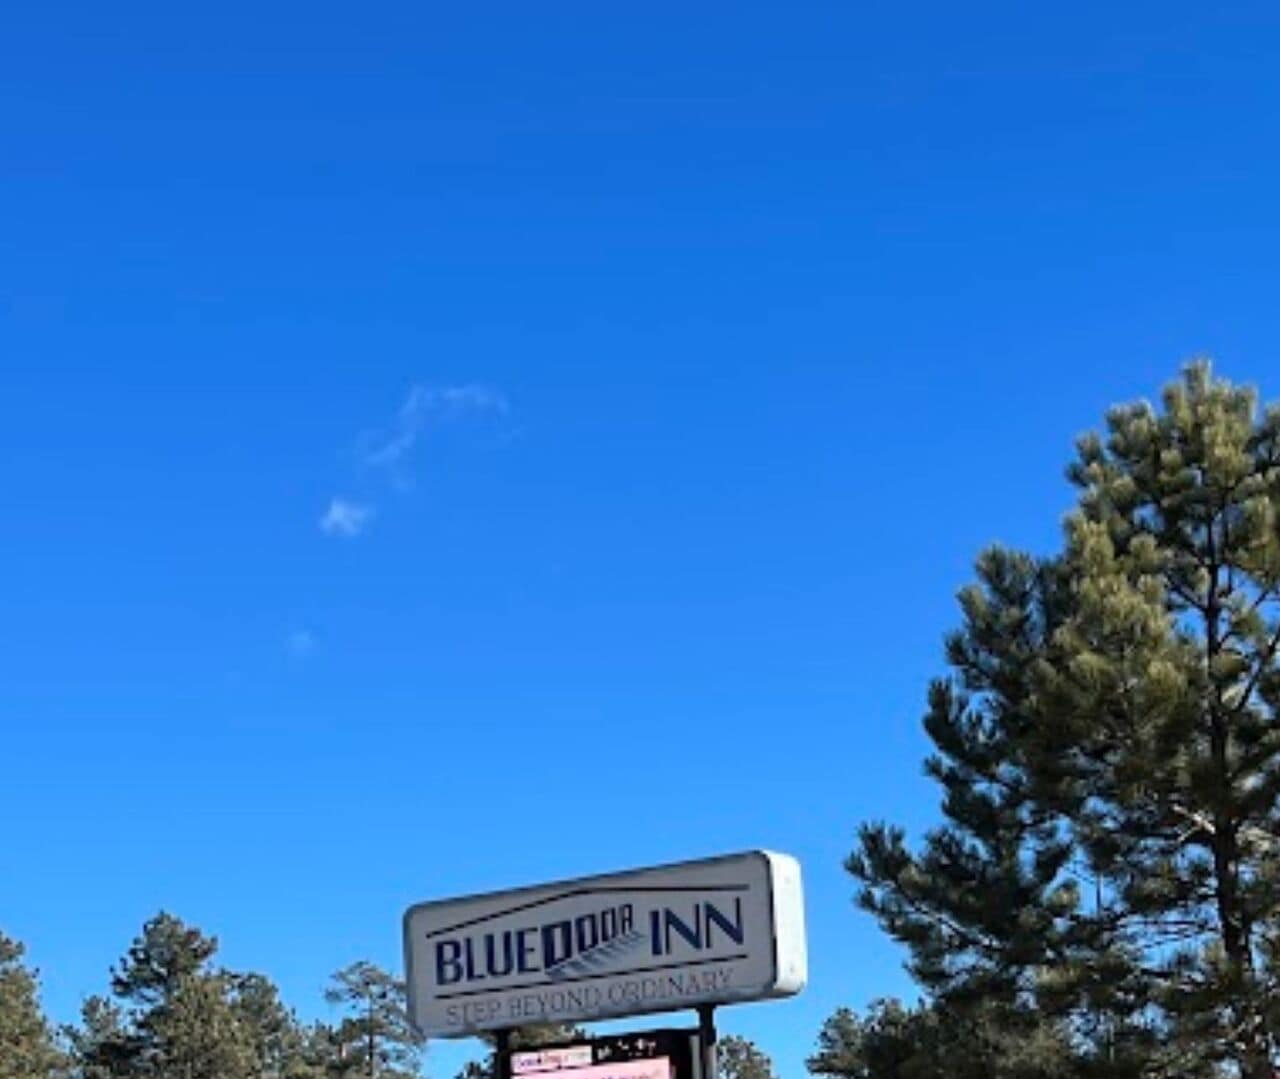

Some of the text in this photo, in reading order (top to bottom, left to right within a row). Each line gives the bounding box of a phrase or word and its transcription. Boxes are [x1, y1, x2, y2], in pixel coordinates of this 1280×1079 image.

[649, 896, 745, 956] INN
[446, 968, 734, 1027] STEP BEYOND ORDINARY
